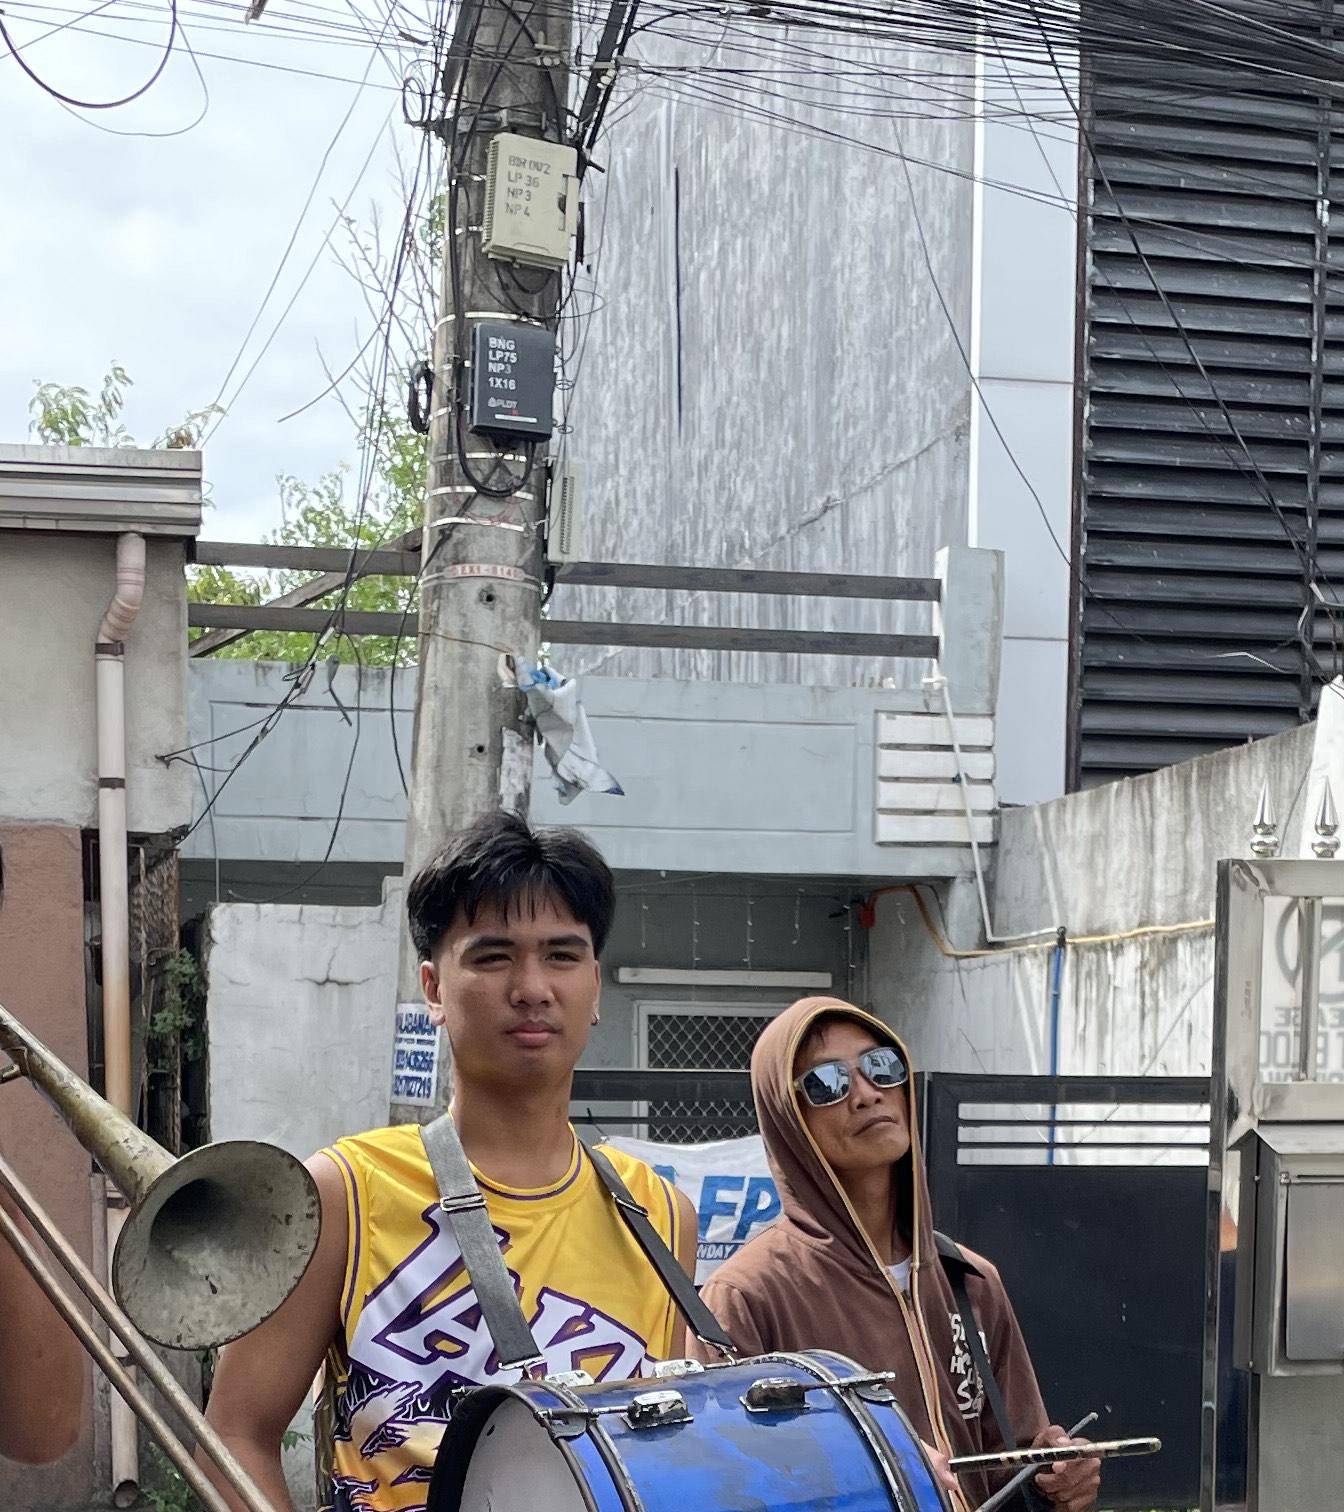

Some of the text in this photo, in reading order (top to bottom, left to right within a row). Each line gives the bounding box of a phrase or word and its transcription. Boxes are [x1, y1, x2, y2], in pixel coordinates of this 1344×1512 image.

[488, 337, 516, 351] BNG
[488, 350, 517, 363] LP75
[488, 362, 512, 374] NP3
[488, 377, 516, 390] 1X16
